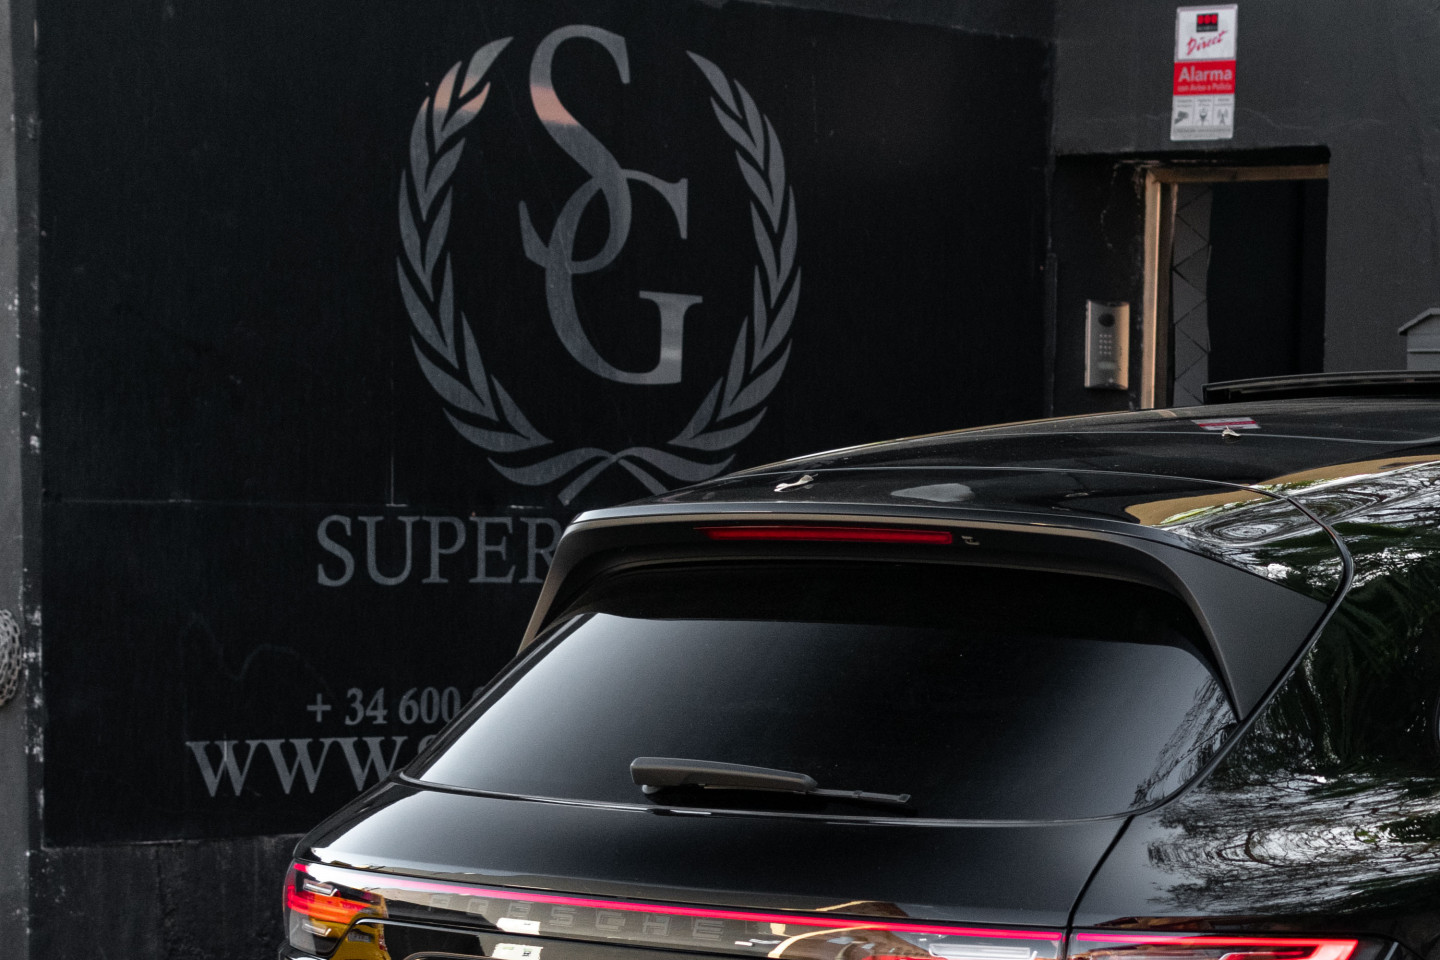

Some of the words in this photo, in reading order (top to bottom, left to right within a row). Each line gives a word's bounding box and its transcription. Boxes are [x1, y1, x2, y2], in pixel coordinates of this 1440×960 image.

[1178, 65, 1232, 82] Alarma
[316, 514, 561, 586] SUPER
[344, 687, 388, 725] 34
[399, 686, 461, 724] 600
